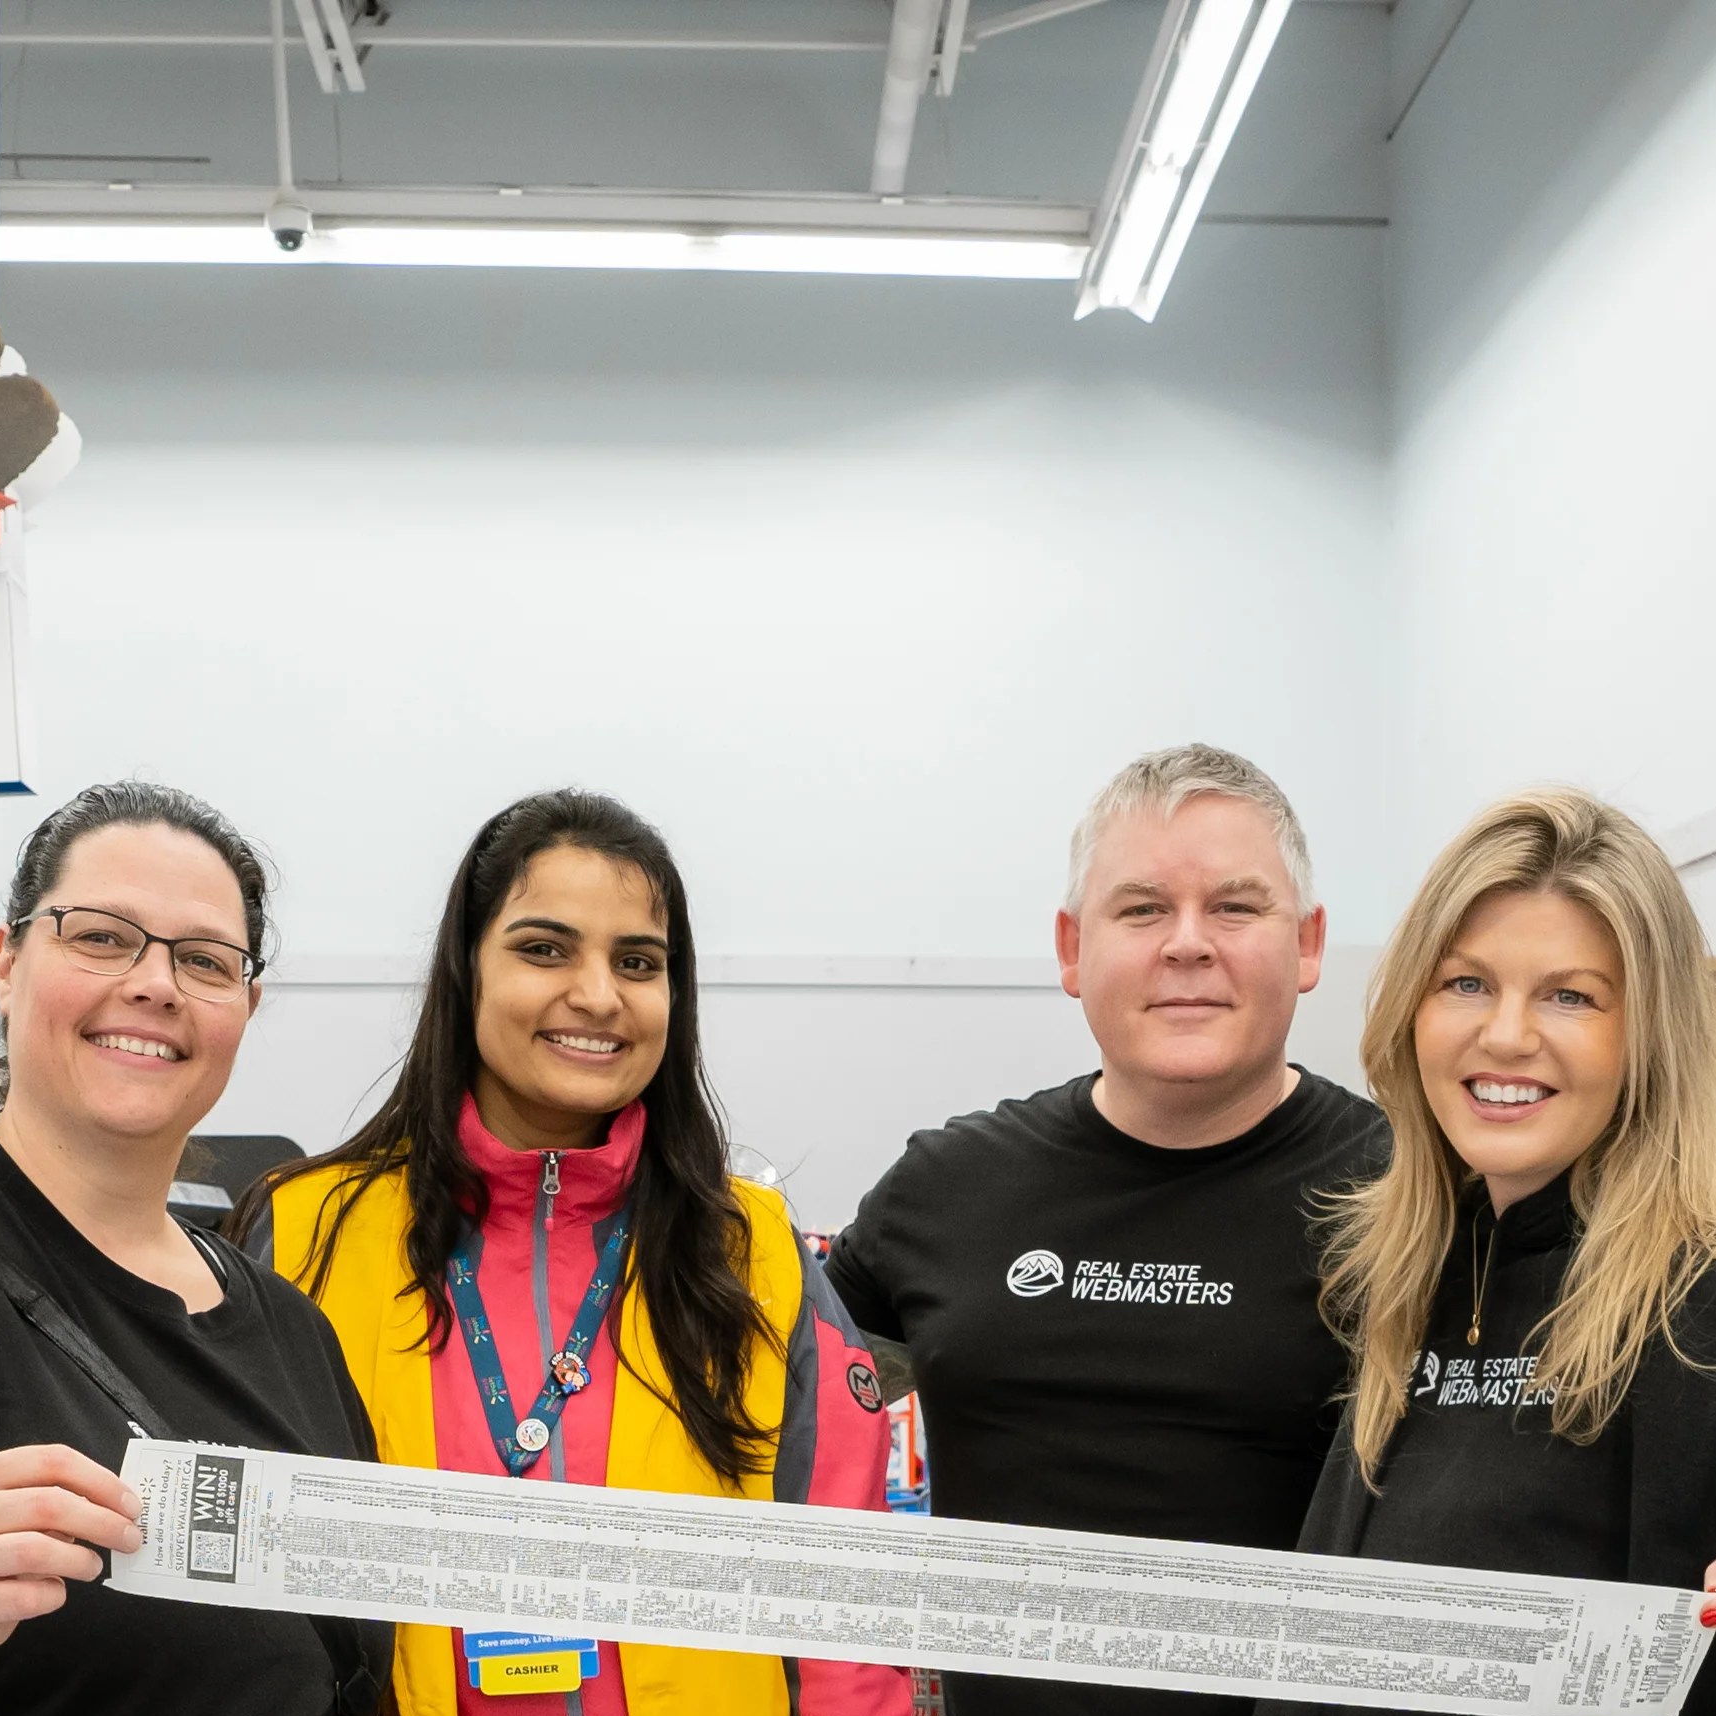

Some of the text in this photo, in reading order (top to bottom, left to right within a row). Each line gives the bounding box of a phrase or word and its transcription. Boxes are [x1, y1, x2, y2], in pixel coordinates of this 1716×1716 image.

[1075, 1260, 1201, 1281] REAL ESTATE
[1071, 1277, 1234, 1305] WEBMASTERS
[1445, 1356, 1539, 1378] REAL ESTATE
[193, 1465, 218, 1521] WIN!
[216, 1469, 229, 1498] $1000
[154, 1459, 173, 1567] How did we do today?
[175, 1459, 193, 1571] SURVEY.WALMART.CA
[215, 1506, 224, 1518] of
[225, 1481, 238, 1525] gift cards
[478, 1639, 499, 1648] Save
[500, 1635, 532, 1648] money.
[533, 1635, 552, 1644] Live
[505, 1664, 559, 1676] CASHIER
[1639, 1664, 1655, 1692] ITEMS
[1648, 1636, 1662, 1660] SOLD
